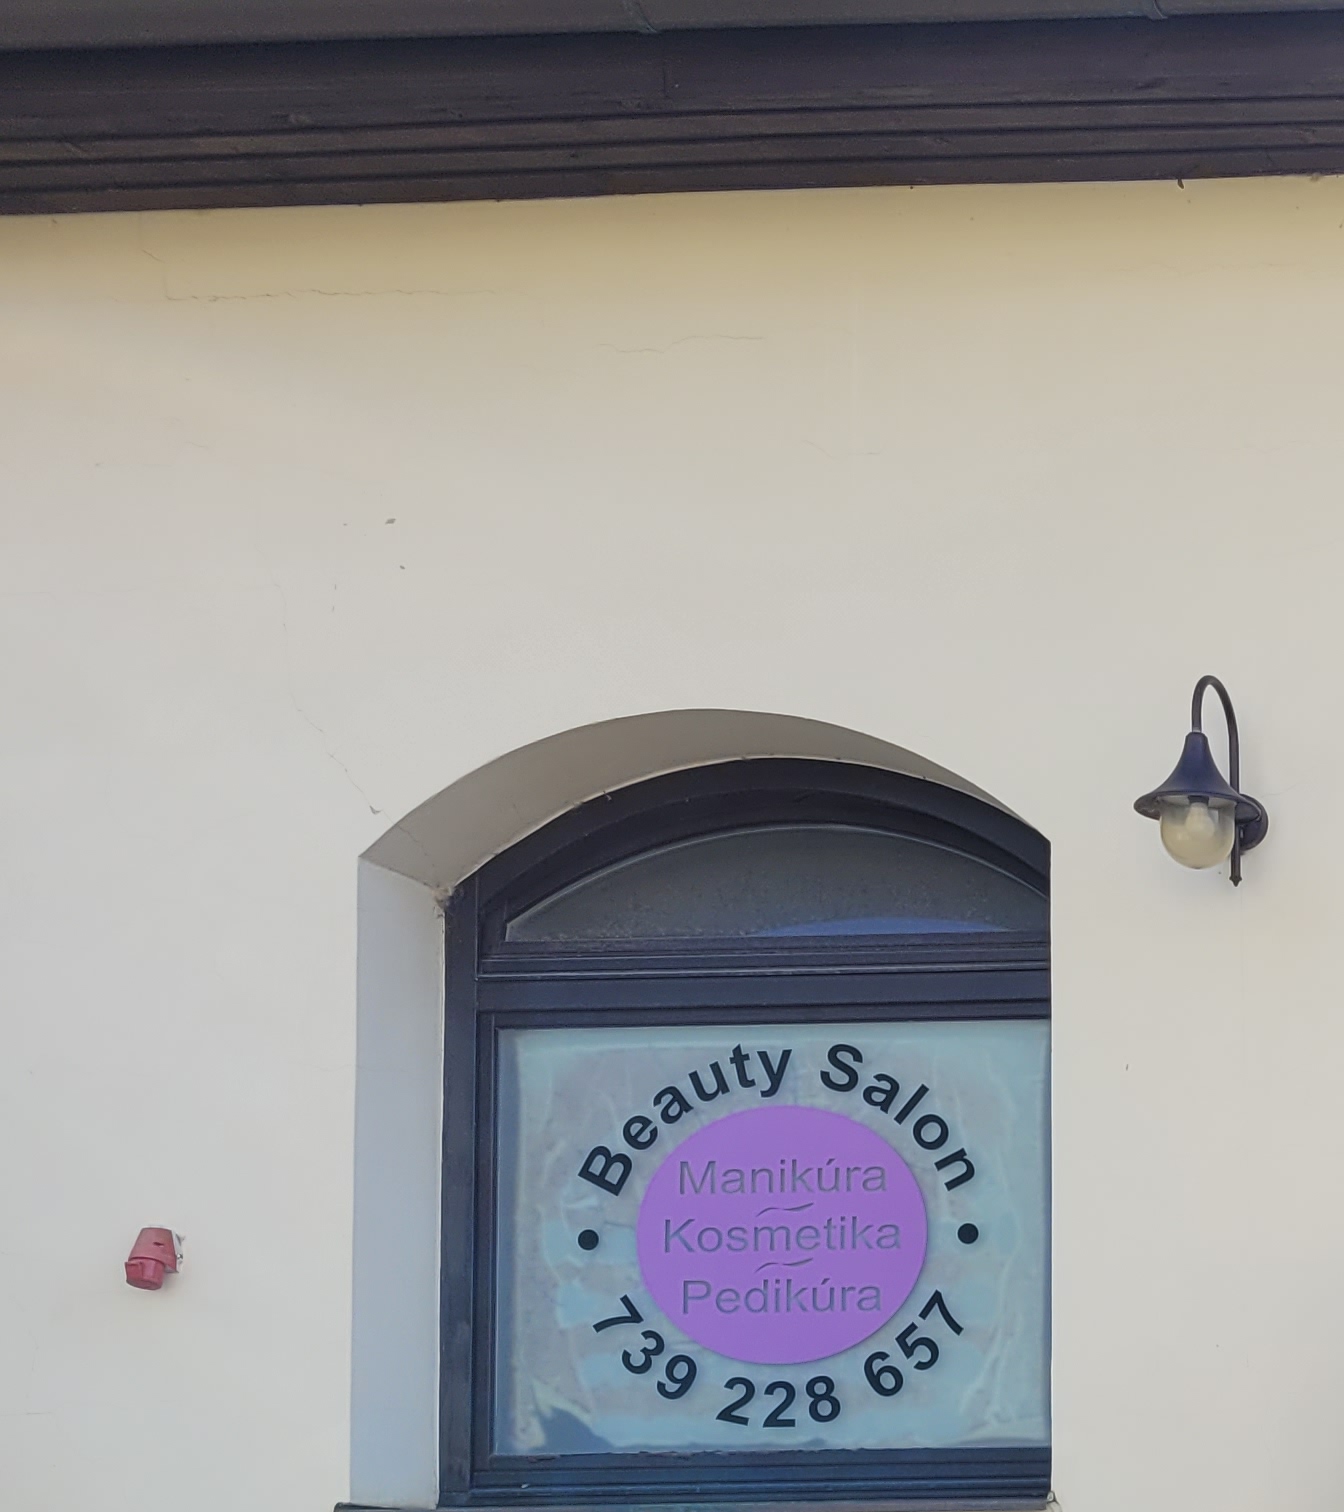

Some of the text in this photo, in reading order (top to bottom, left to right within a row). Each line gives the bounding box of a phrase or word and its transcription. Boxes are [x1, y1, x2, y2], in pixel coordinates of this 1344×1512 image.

[577, 1043, 976, 1197] Beauty Salon
[678, 1157, 887, 1195] Manikúra
[663, 1214, 902, 1254] Kosmetika
[681, 1276, 883, 1315] Pedikúra
[592, 1290, 966, 1428] 739 228 657
